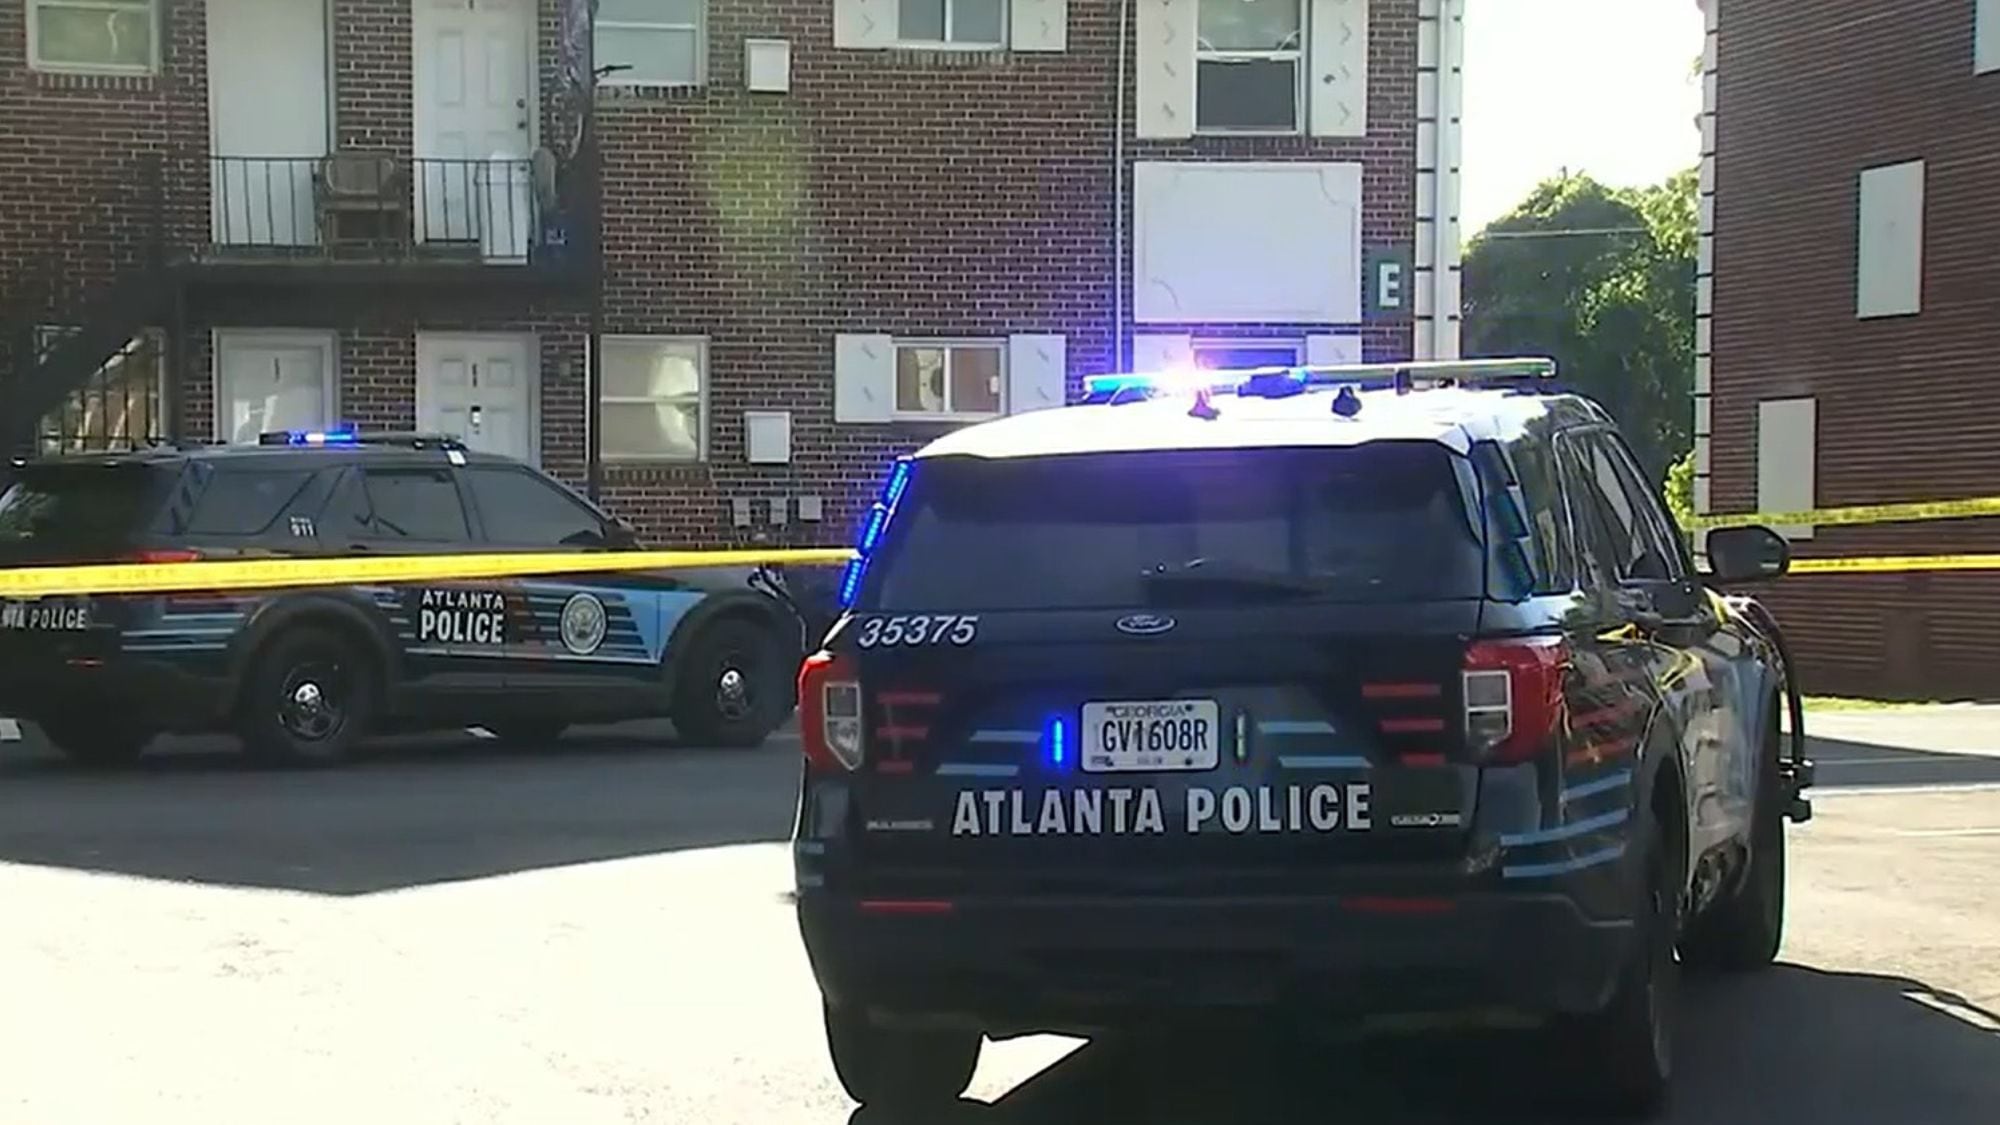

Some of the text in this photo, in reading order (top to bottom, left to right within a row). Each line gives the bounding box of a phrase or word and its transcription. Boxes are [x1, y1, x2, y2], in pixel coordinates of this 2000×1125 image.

[1379, 263, 1400, 306] E
[421, 589, 505, 609] ATLANTA
[29, 608, 87, 629] POLICE
[420, 609, 504, 643] POLICE
[858, 615, 978, 648] 35375
[1112, 704, 1187, 719] GEORGIA
[1102, 719, 1208, 753] GV1608R
[952, 783, 1372, 836] ATLANTA POLICE
